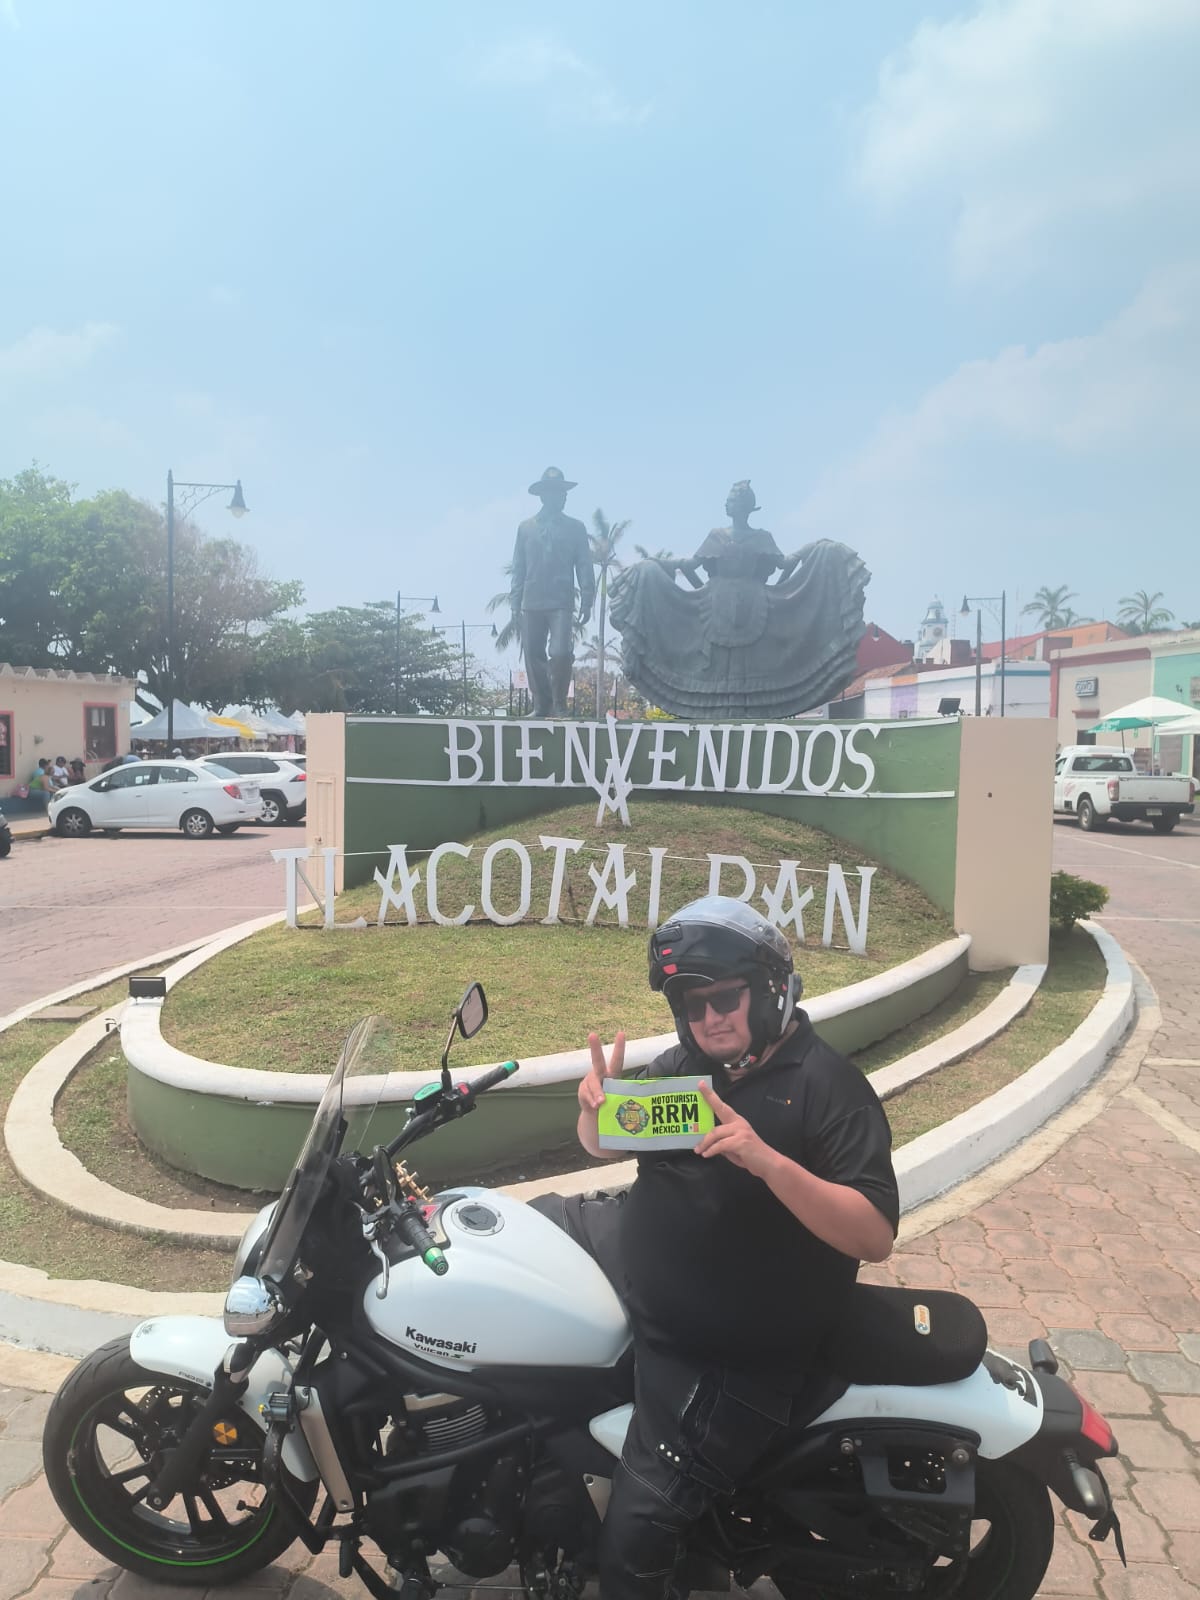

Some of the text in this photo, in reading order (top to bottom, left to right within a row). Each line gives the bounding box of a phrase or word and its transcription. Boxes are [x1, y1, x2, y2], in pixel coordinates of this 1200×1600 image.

[444, 713, 881, 794] BIENVENIDOS
[588, 758, 633, 828] A
[651, 1094, 698, 1105] MOTOTURISTA
[652, 1103, 699, 1125] RRM
[405, 1326, 477, 1353] Kawasaki
[413, 1343, 449, 1357] Vulcan
